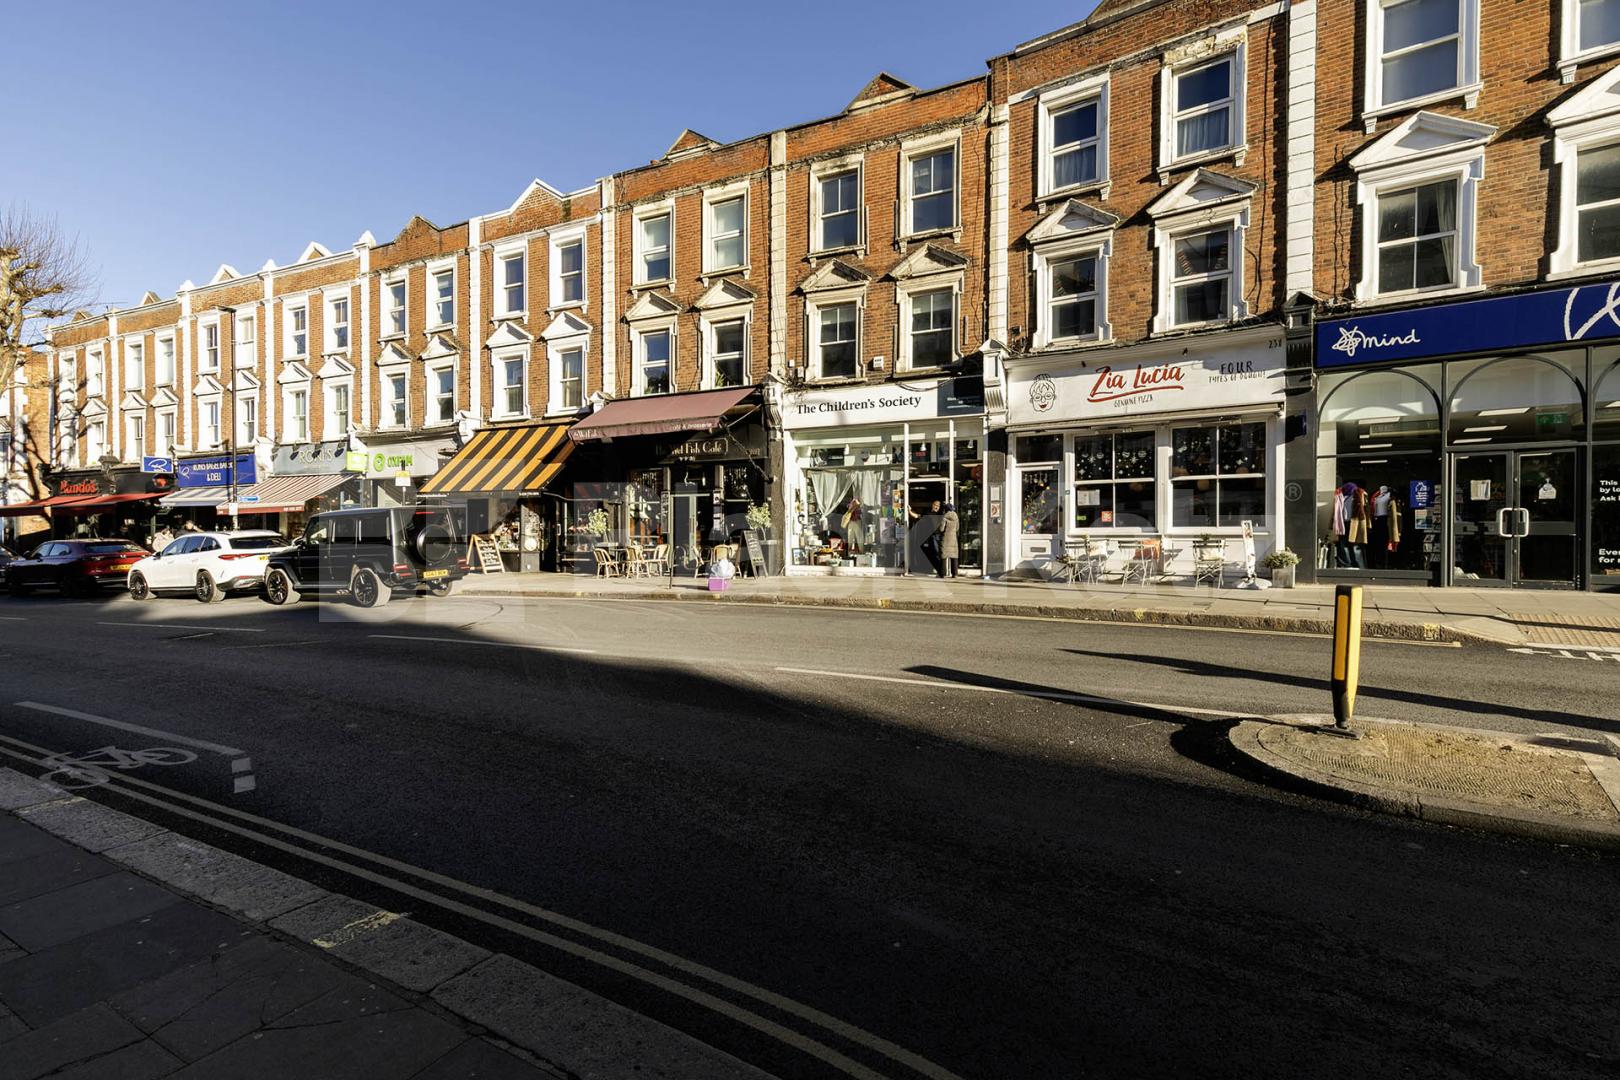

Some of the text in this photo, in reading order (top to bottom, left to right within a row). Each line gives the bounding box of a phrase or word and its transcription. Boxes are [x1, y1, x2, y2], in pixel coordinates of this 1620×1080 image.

[1361, 328, 1421, 349] mind
[1220, 360, 1253, 375] FOUR
[1089, 363, 1185, 398] Zia Lucia
[797, 395, 922, 414] The Children's Society
[685, 442, 701, 455] Fish
[702, 439, 722, 454] Café
[1599, 486, 1611, 494] by
[1598, 556, 1616, 564] for
